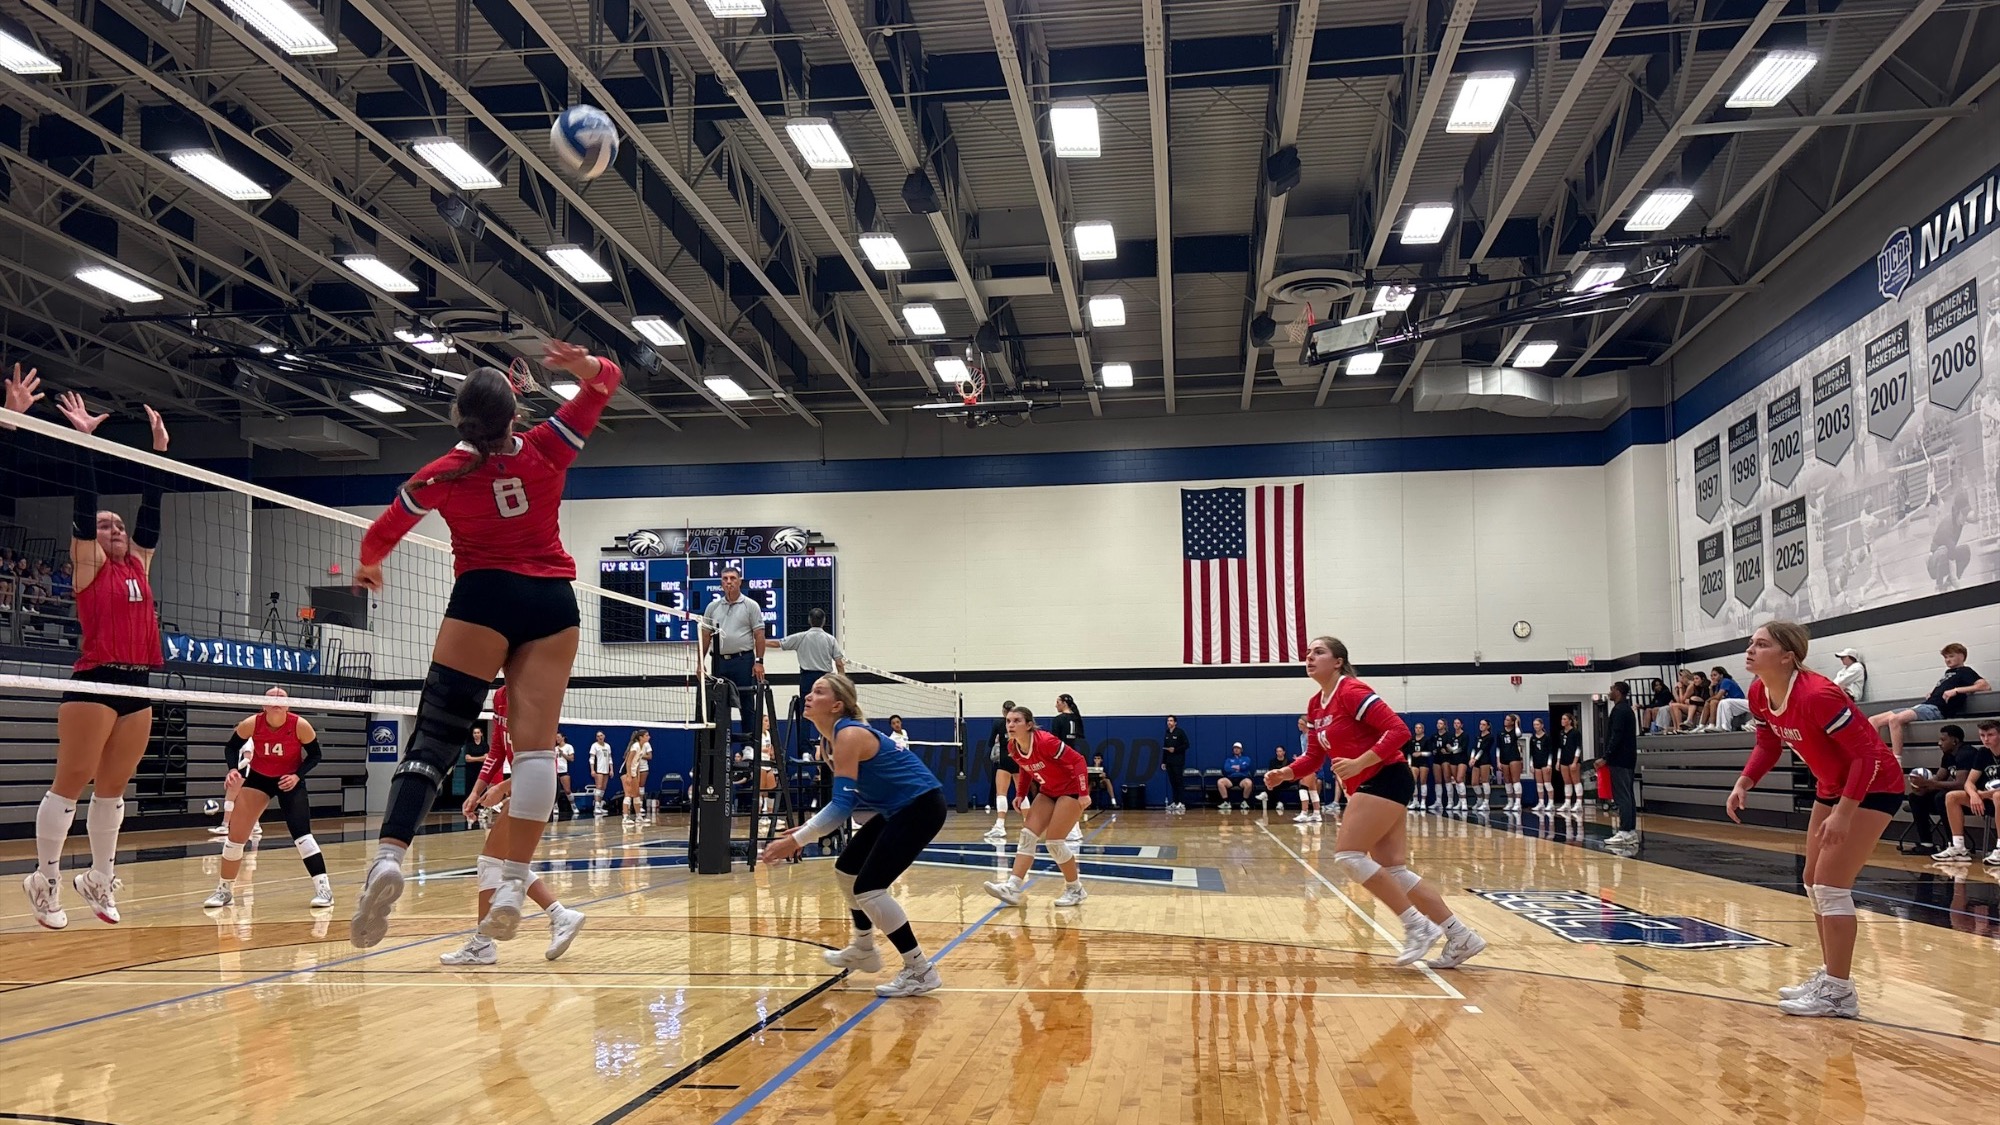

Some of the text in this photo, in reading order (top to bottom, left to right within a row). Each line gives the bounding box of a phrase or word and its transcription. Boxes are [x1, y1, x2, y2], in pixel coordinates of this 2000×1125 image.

[1919, 175, 2000, 270] NATI
[1879, 236, 1910, 287] NJCAA
[1932, 287, 1970, 320] WOMEN'S
[1927, 299, 1977, 338] BASKETBALL
[1871, 328, 1903, 357] WOMEN'S
[1866, 339, 1909, 373] BASKETBALL
[1931, 335, 1977, 385] 2008
[1817, 362, 1846, 388] WOMEN'S
[1814, 373, 1850, 402] VOLLEYBALL
[1870, 371, 1908, 416] 2007
[1771, 392, 1796, 415] WOMEN'S
[1768, 403, 1800, 429] BASKETBALL
[1817, 403, 1850, 443] 2003
[1729, 428, 1757, 451] BASKETBALL
[1735, 420, 1750, 436] MEN'S
[1771, 430, 1800, 466] 2002
[1695, 450, 1719, 471] BASKETBALL
[1731, 453, 1757, 485] 1998
[492, 477, 529, 518] 8
[1697, 474, 1719, 502] 1997
[1780, 504, 1797, 518] MEN'S
[688, 529, 714, 537] HOME
[730, 528, 746, 536] THE
[1736, 520, 1758, 537] WOMEN'S
[1773, 513, 1805, 534] BASKETBALL
[671, 535, 763, 555] EAGLES
[1703, 537, 1717, 550] MEN'S
[1733, 531, 1761, 549] BASKETBALL
[787, 557, 802, 567] PLY
[817, 557, 832, 566] KLS
[1705, 548, 1717, 560] GOLF
[1776, 541, 1805, 572] 2025
[601, 562, 616, 572] PLY
[630, 562, 645, 571] KLS
[1736, 556, 1761, 585] 2024
[125, 579, 143, 602] 11
[661, 582, 680, 591] HOME
[749, 580, 773, 589] GUEST
[1701, 569, 1723, 596] 2023
[673, 592, 685, 610] 3
[765, 590, 777, 609] 3
[655, 614, 671, 623] WON
[665, 626, 671, 639] 1
[771, 624, 777, 637] 1
[186, 638, 255, 667] EAGLES
[264, 742, 284, 756] 14
[1504, 736, 1511, 744] 15
[1034, 772, 1046, 785] 3
